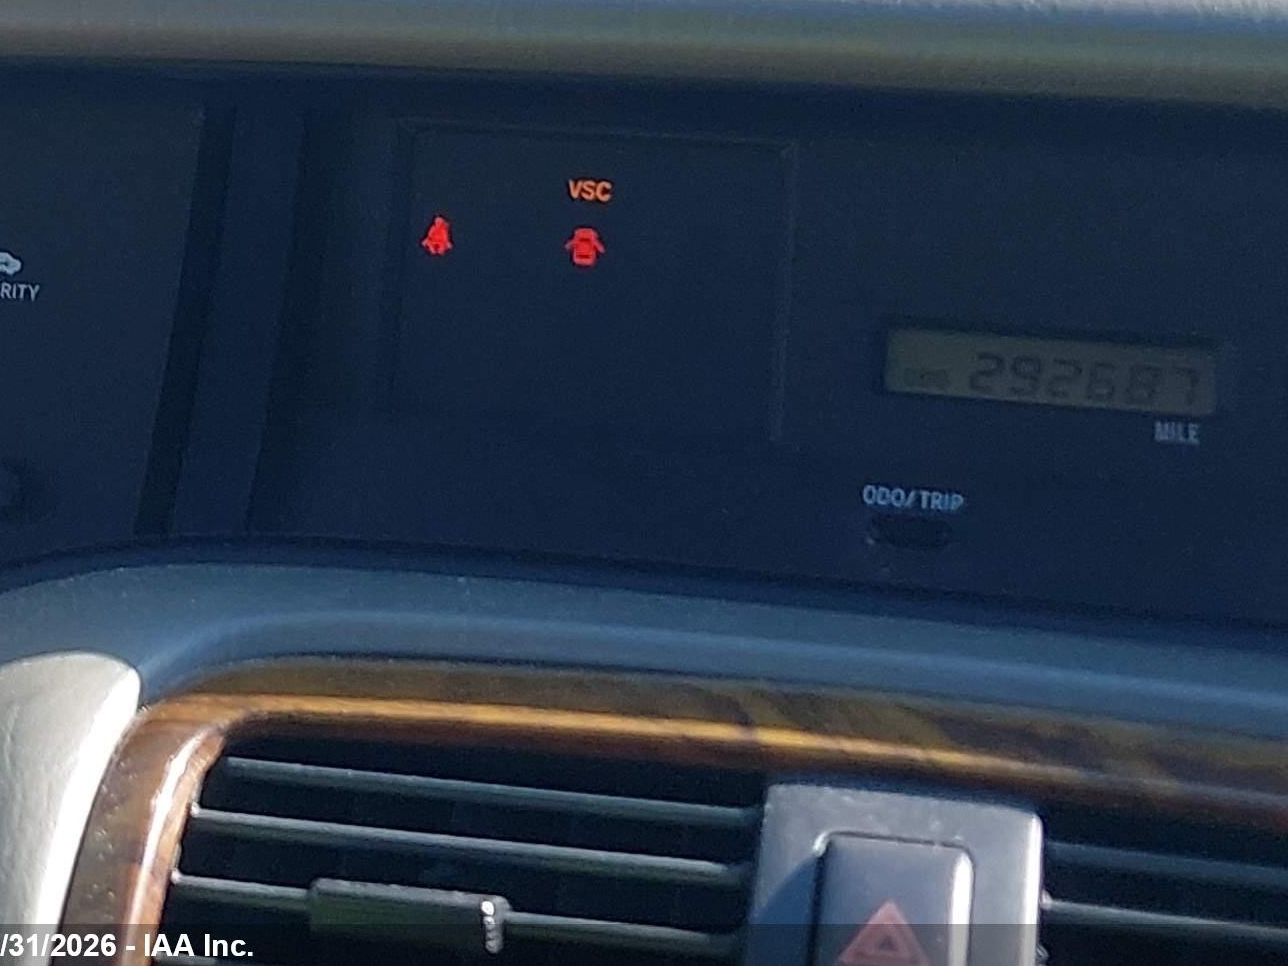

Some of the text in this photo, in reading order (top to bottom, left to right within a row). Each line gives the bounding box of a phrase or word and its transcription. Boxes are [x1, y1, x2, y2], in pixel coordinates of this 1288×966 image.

[568, 179, 613, 202] VSC
[1154, 421, 1199, 445] MILE
[862, 484, 965, 511] ODO/TRIP
